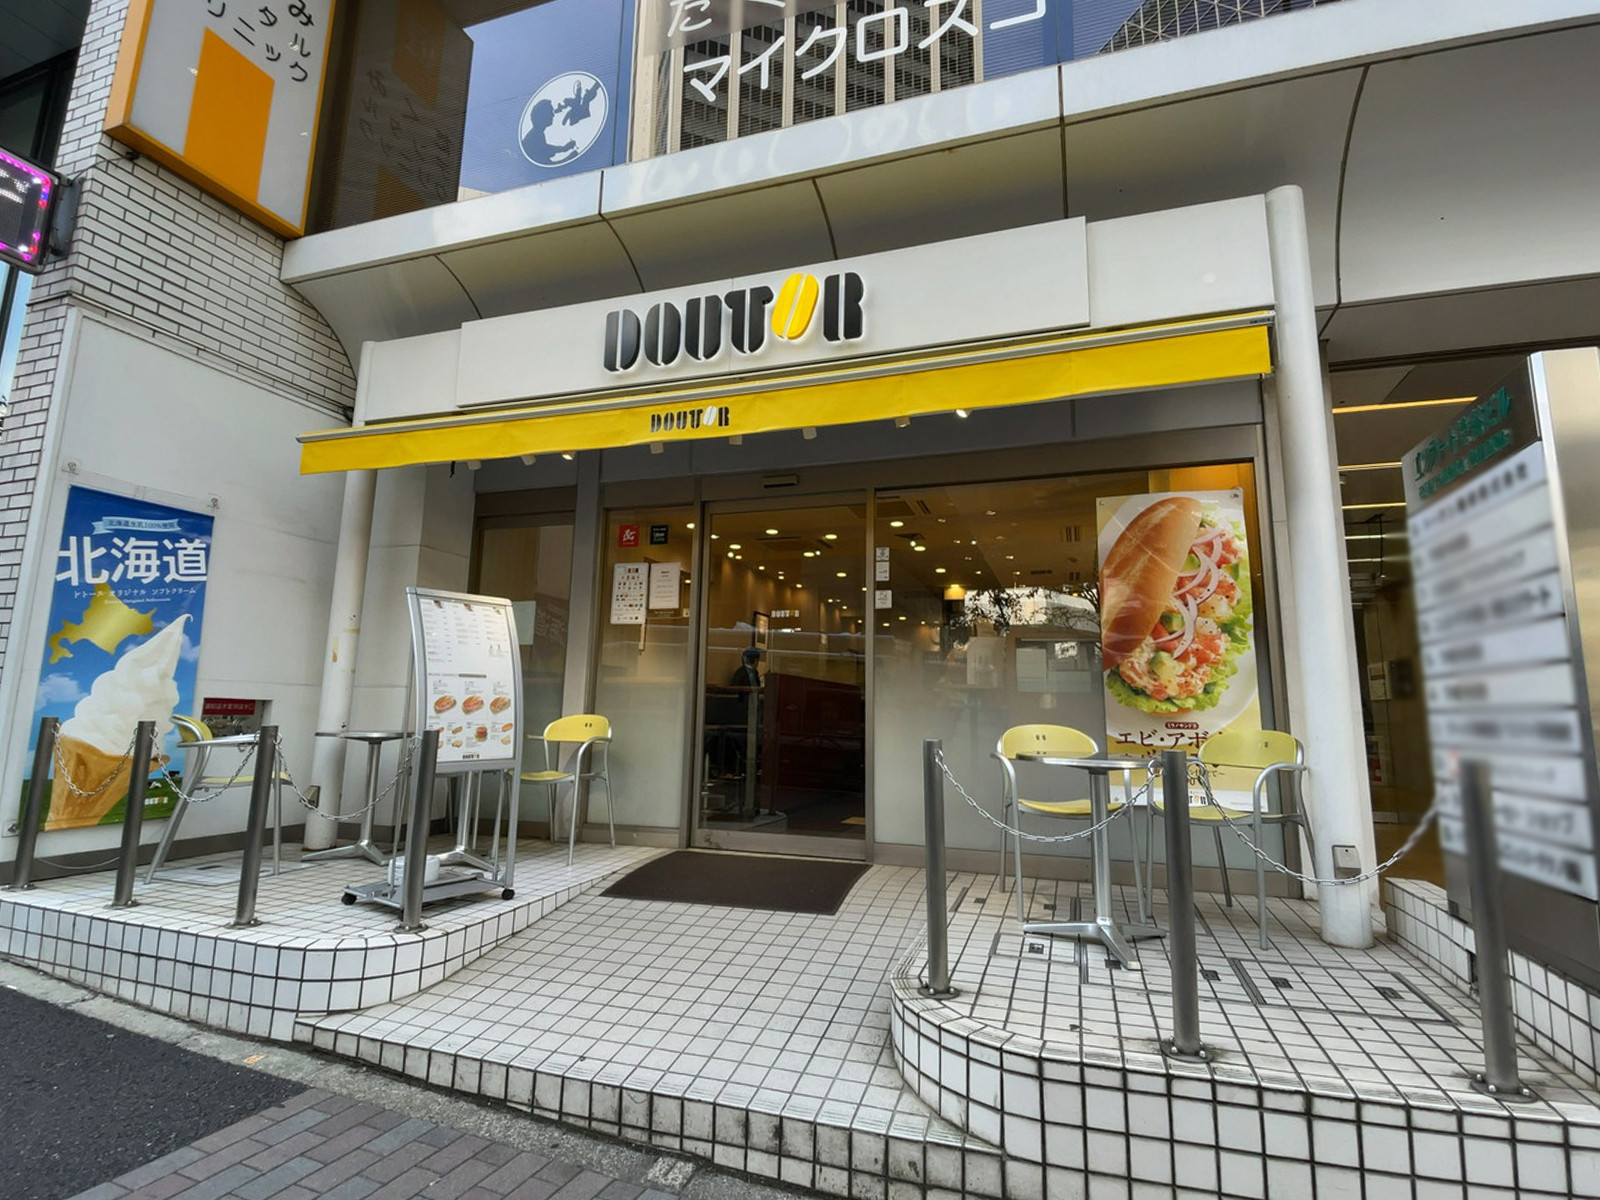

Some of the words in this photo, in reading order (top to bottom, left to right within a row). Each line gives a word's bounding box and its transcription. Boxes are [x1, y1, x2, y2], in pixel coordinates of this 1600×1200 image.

[604, 272, 865, 372] DOUTOR
[650, 406, 730, 433] DOUTOR
[55, 536, 208, 586] 北海道
